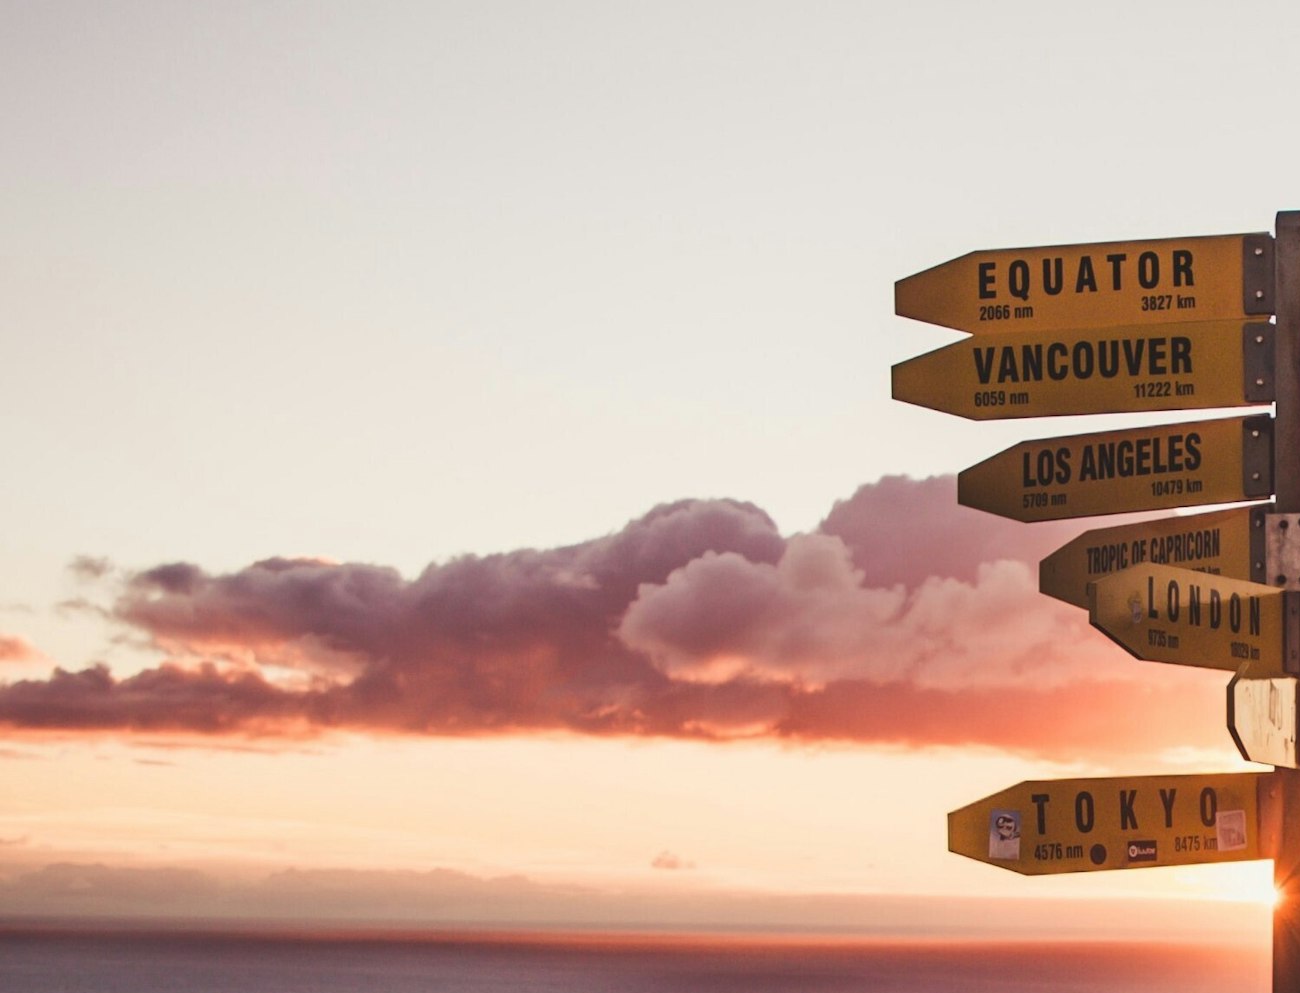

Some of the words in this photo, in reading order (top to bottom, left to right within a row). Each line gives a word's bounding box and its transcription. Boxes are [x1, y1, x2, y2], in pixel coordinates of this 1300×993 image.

[978, 249, 1195, 301] EQUATOR
[979, 305, 1010, 321] 2066
[1014, 304, 1033, 319] nm
[1141, 295, 1173, 311] 3827
[1176, 294, 1195, 310] km
[973, 336, 1193, 384] VANCOUVER
[974, 392, 1005, 407] 6059
[1009, 391, 1029, 406] nm
[1133, 383, 1171, 398] 11222
[1175, 381, 1194, 396] km
[1022, 448, 1071, 487] LOS
[1079, 432, 1202, 482] ANGELES
[1022, 493, 1048, 508] 5709
[1051, 492, 1067, 506] nm
[1151, 479, 1183, 496] 10479
[1186, 478, 1202, 493] km
[1087, 542, 1128, 574] TROPIC
[1131, 539, 1147, 565] OF
[1150, 528, 1220, 564] CAPRICORN
[1148, 576, 1260, 636] LONDON
[1031, 787, 1218, 835] TOKYO
[1034, 843, 1062, 860] 4576
[1066, 845, 1083, 859] nm
[1174, 836, 1201, 852] 8475
[1204, 835, 1218, 850] km
